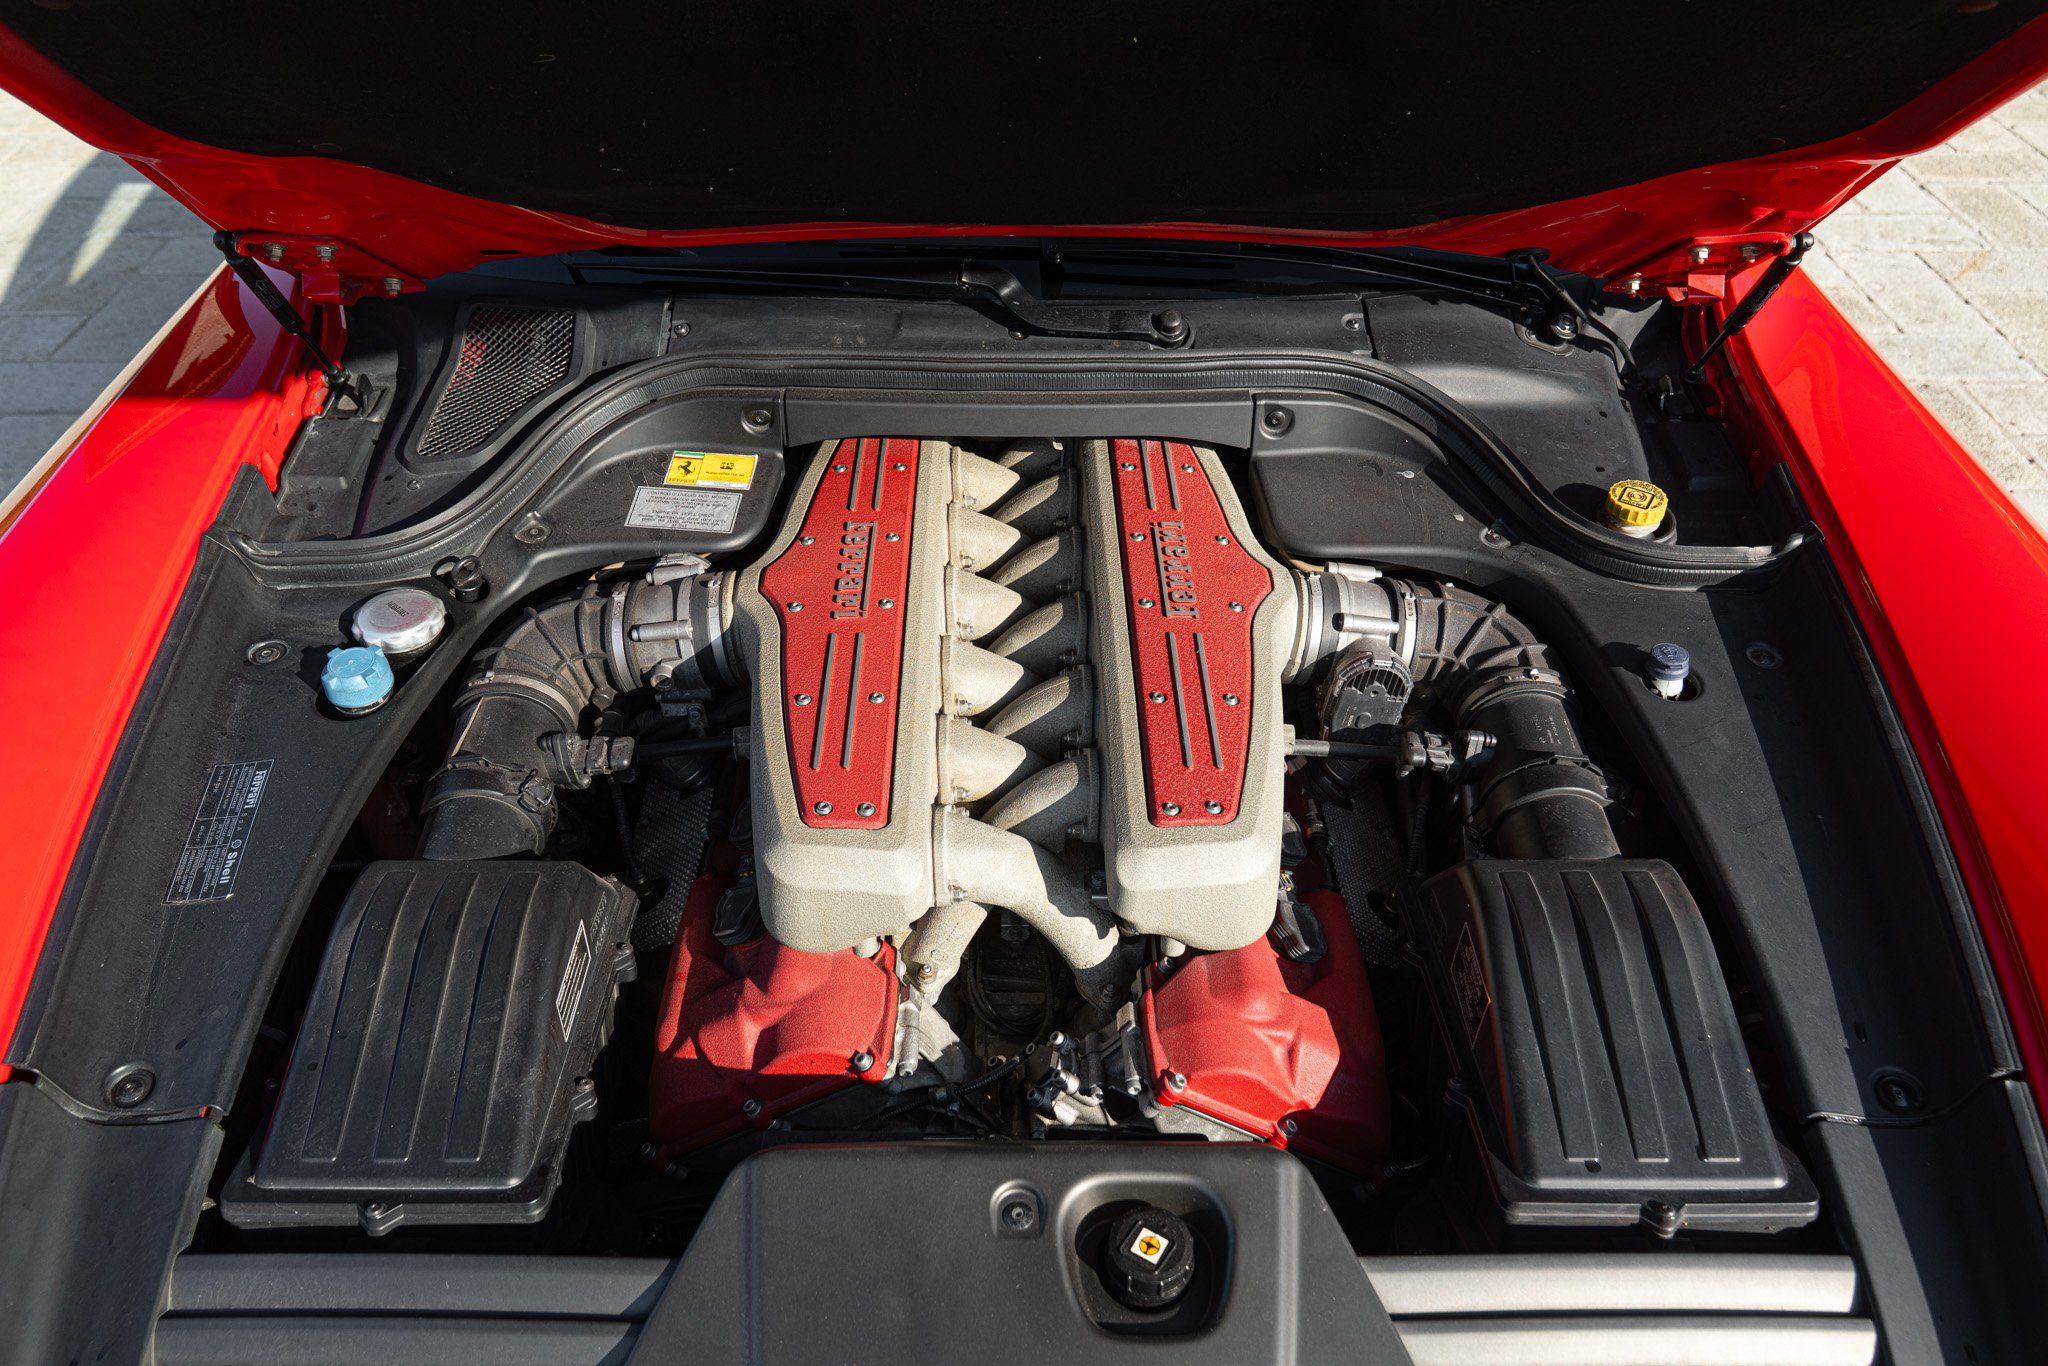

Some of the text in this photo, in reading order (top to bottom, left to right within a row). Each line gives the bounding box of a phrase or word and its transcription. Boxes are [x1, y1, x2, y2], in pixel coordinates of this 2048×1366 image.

[830, 521, 877, 619] Ferrari
[1149, 521, 1198, 619] Ferrari
[244, 769, 267, 808] Ferrari
[219, 851, 238, 884] Shell
